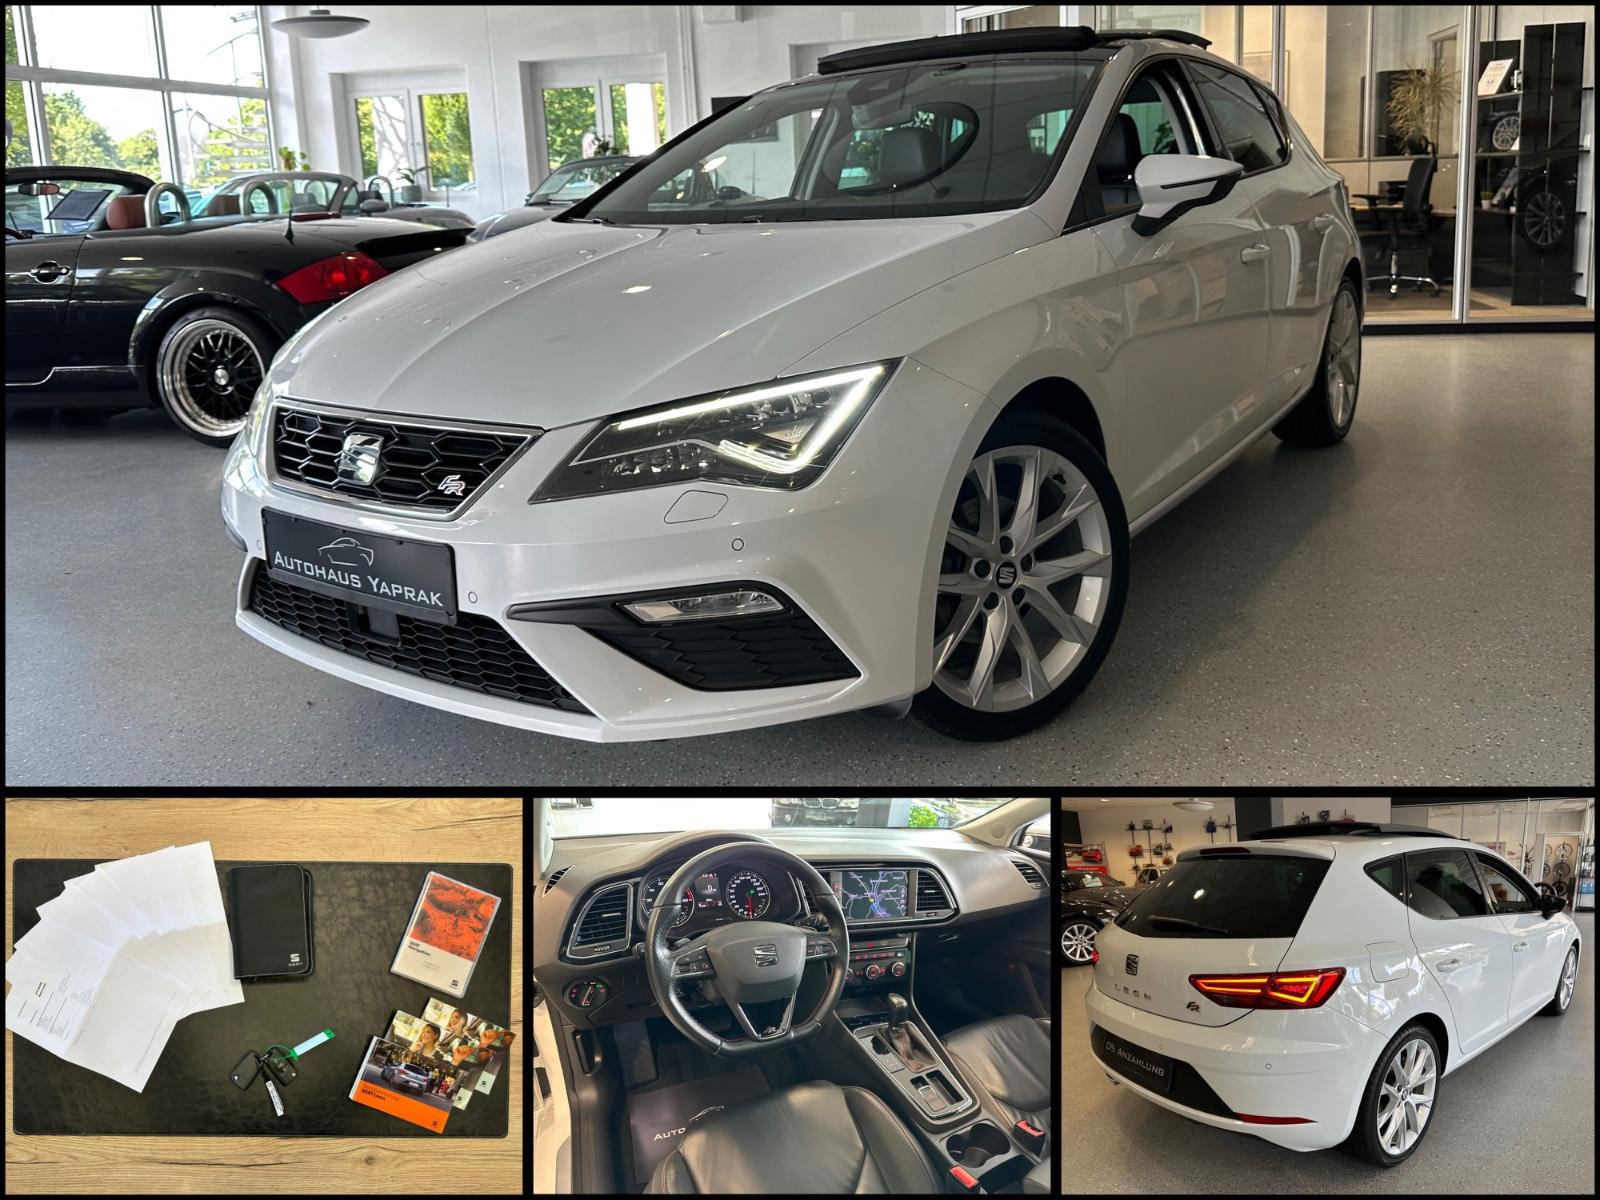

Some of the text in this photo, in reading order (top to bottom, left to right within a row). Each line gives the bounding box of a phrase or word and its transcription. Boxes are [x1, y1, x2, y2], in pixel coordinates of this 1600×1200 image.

[274, 551, 444, 607] AUTOHAUS YAPRAK
[1115, 984, 1152, 1001] LEON
[1117, 1048, 1165, 1076] ANZAHLUNG
